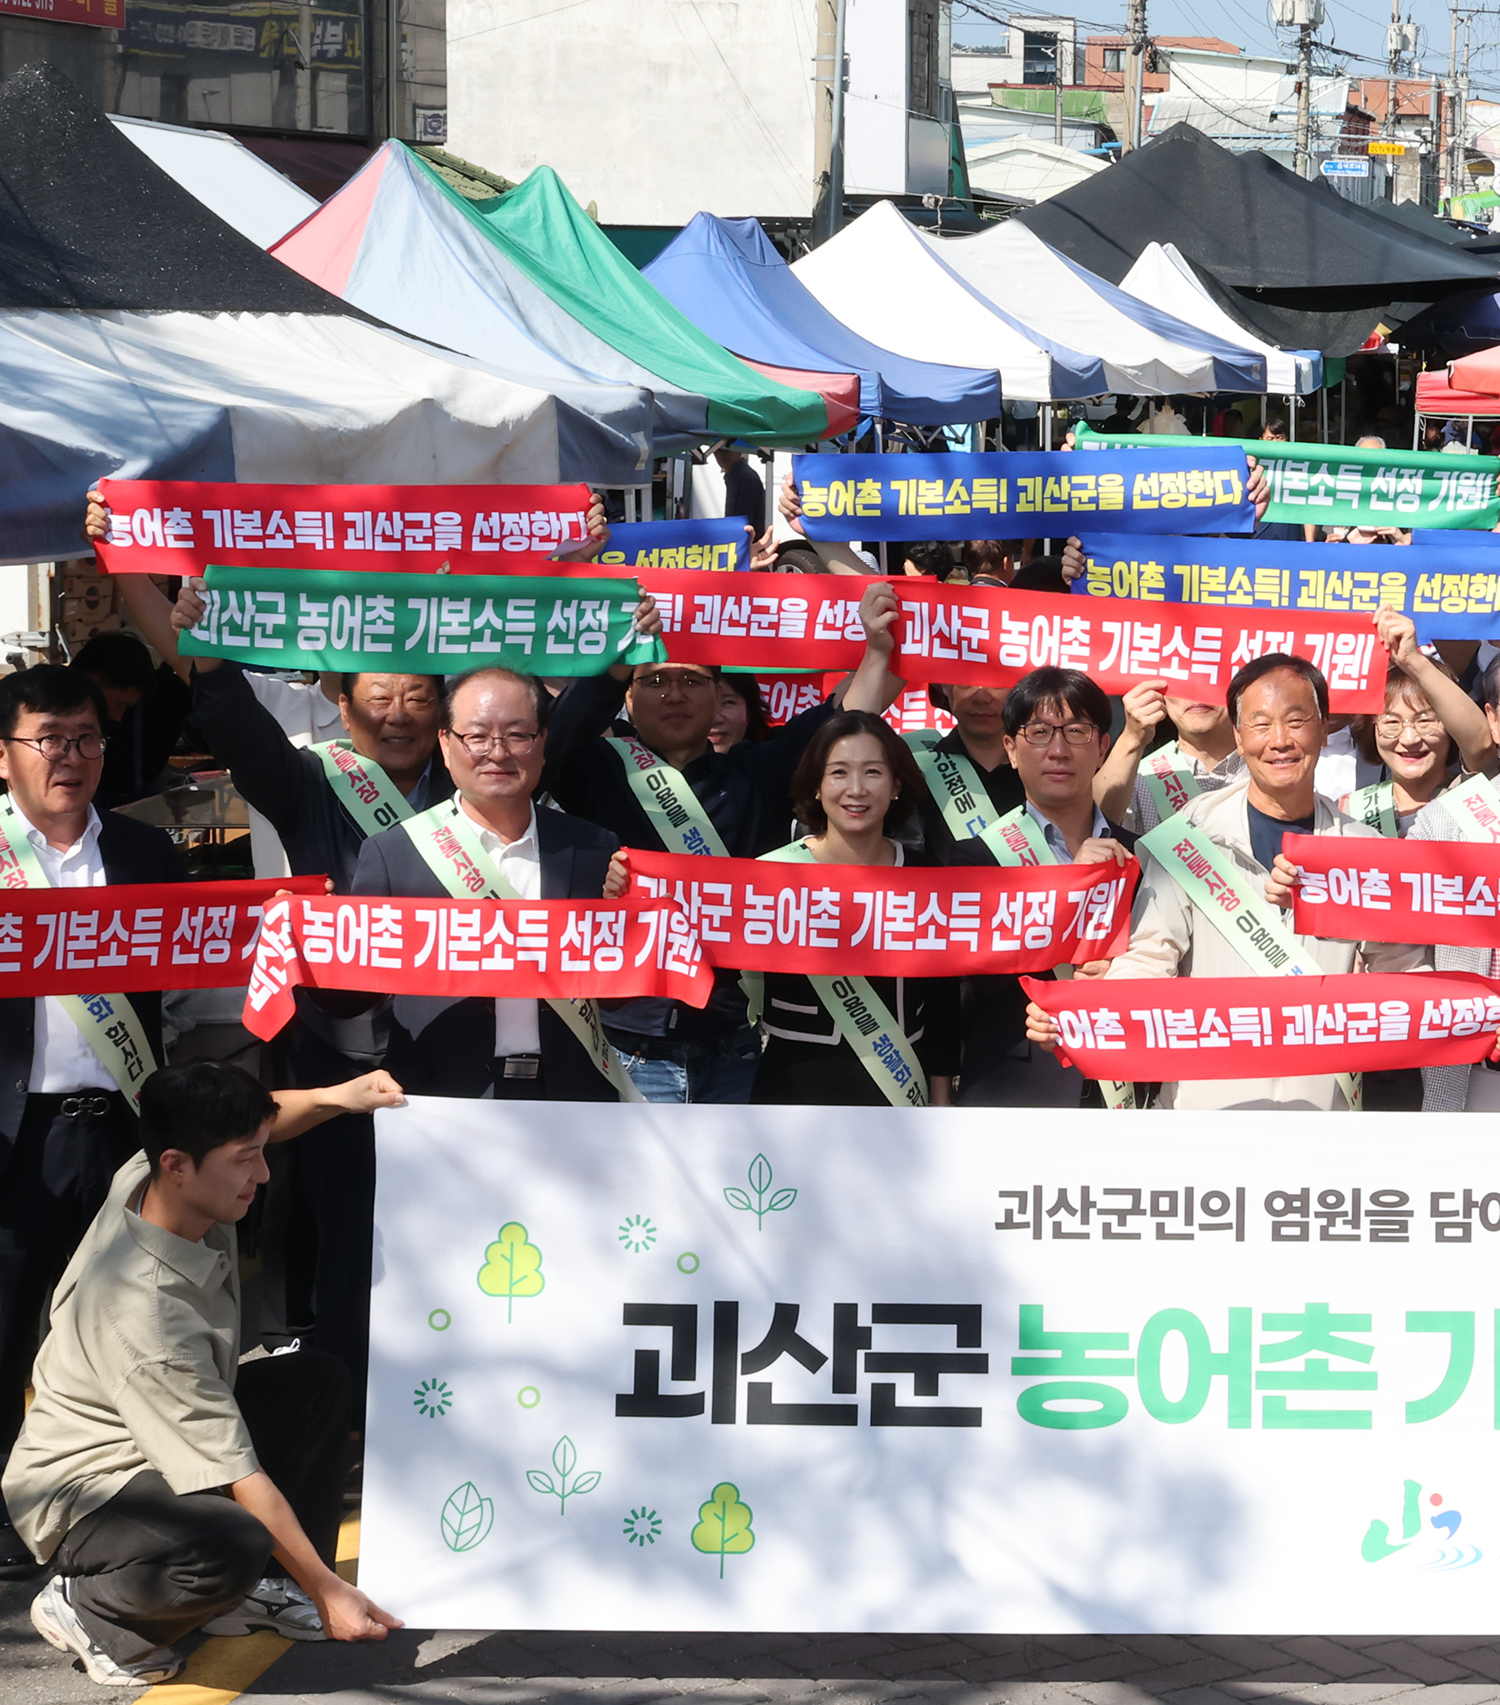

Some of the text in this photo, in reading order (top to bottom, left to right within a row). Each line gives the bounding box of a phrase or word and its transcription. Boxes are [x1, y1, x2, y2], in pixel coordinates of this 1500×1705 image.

[801, 470, 1242, 518] 농어촌 기본소득! 괴산군을 선정한다
[1370, 465, 1426, 512] 선정
[202, 510, 333, 550] 기본소득!
[344, 511, 462, 550] 괴산군을
[1086, 559, 1165, 601] 농어촌
[1173, 562, 1289, 607] 기본소득!
[1296, 569, 1406, 610] 괴산군을
[297, 593, 394, 652] 농어촌
[405, 597, 536, 654] 기본소득
[545, 599, 609, 654] 선정
[691, 598, 807, 639] 괴산군을
[813, 599, 867, 641] 선정
[901, 601, 989, 663] 괴산군
[999, 614, 1091, 670] 농어촌
[1099, 620, 1223, 685] 기본소득
[1305, 634, 1373, 690] 기원!
[431, 826, 486, 893] 전통시장
[1297, 866, 1391, 910] 농어촌
[743, 886, 841, 947] 농어촌
[851, 890, 981, 951] 기본소득
[991, 891, 1056, 951] 선정
[1172, 838, 1290, 969] 전통시장 이용을
[34, 908, 163, 970] 기본소득
[172, 904, 234, 965] 선정
[301, 901, 402, 969] 농어촌
[415, 908, 548, 972] 기본소득
[559, 909, 625, 972] 선정
[634, 909, 701, 977] 기원!
[831, 976, 880, 1037] 이용을
[1049, 1012, 1127, 1049] 어촌
[1130, 1007, 1272, 1048] 기본소득!
[1282, 1003, 1409, 1046] 괴산군을
[994, 1185, 1246, 1242] 괴산군민의
[1263, 1187, 1414, 1244] 염원을
[615, 1301, 989, 1428] 괴산군
[1011, 1303, 1378, 1430] 농어촌
